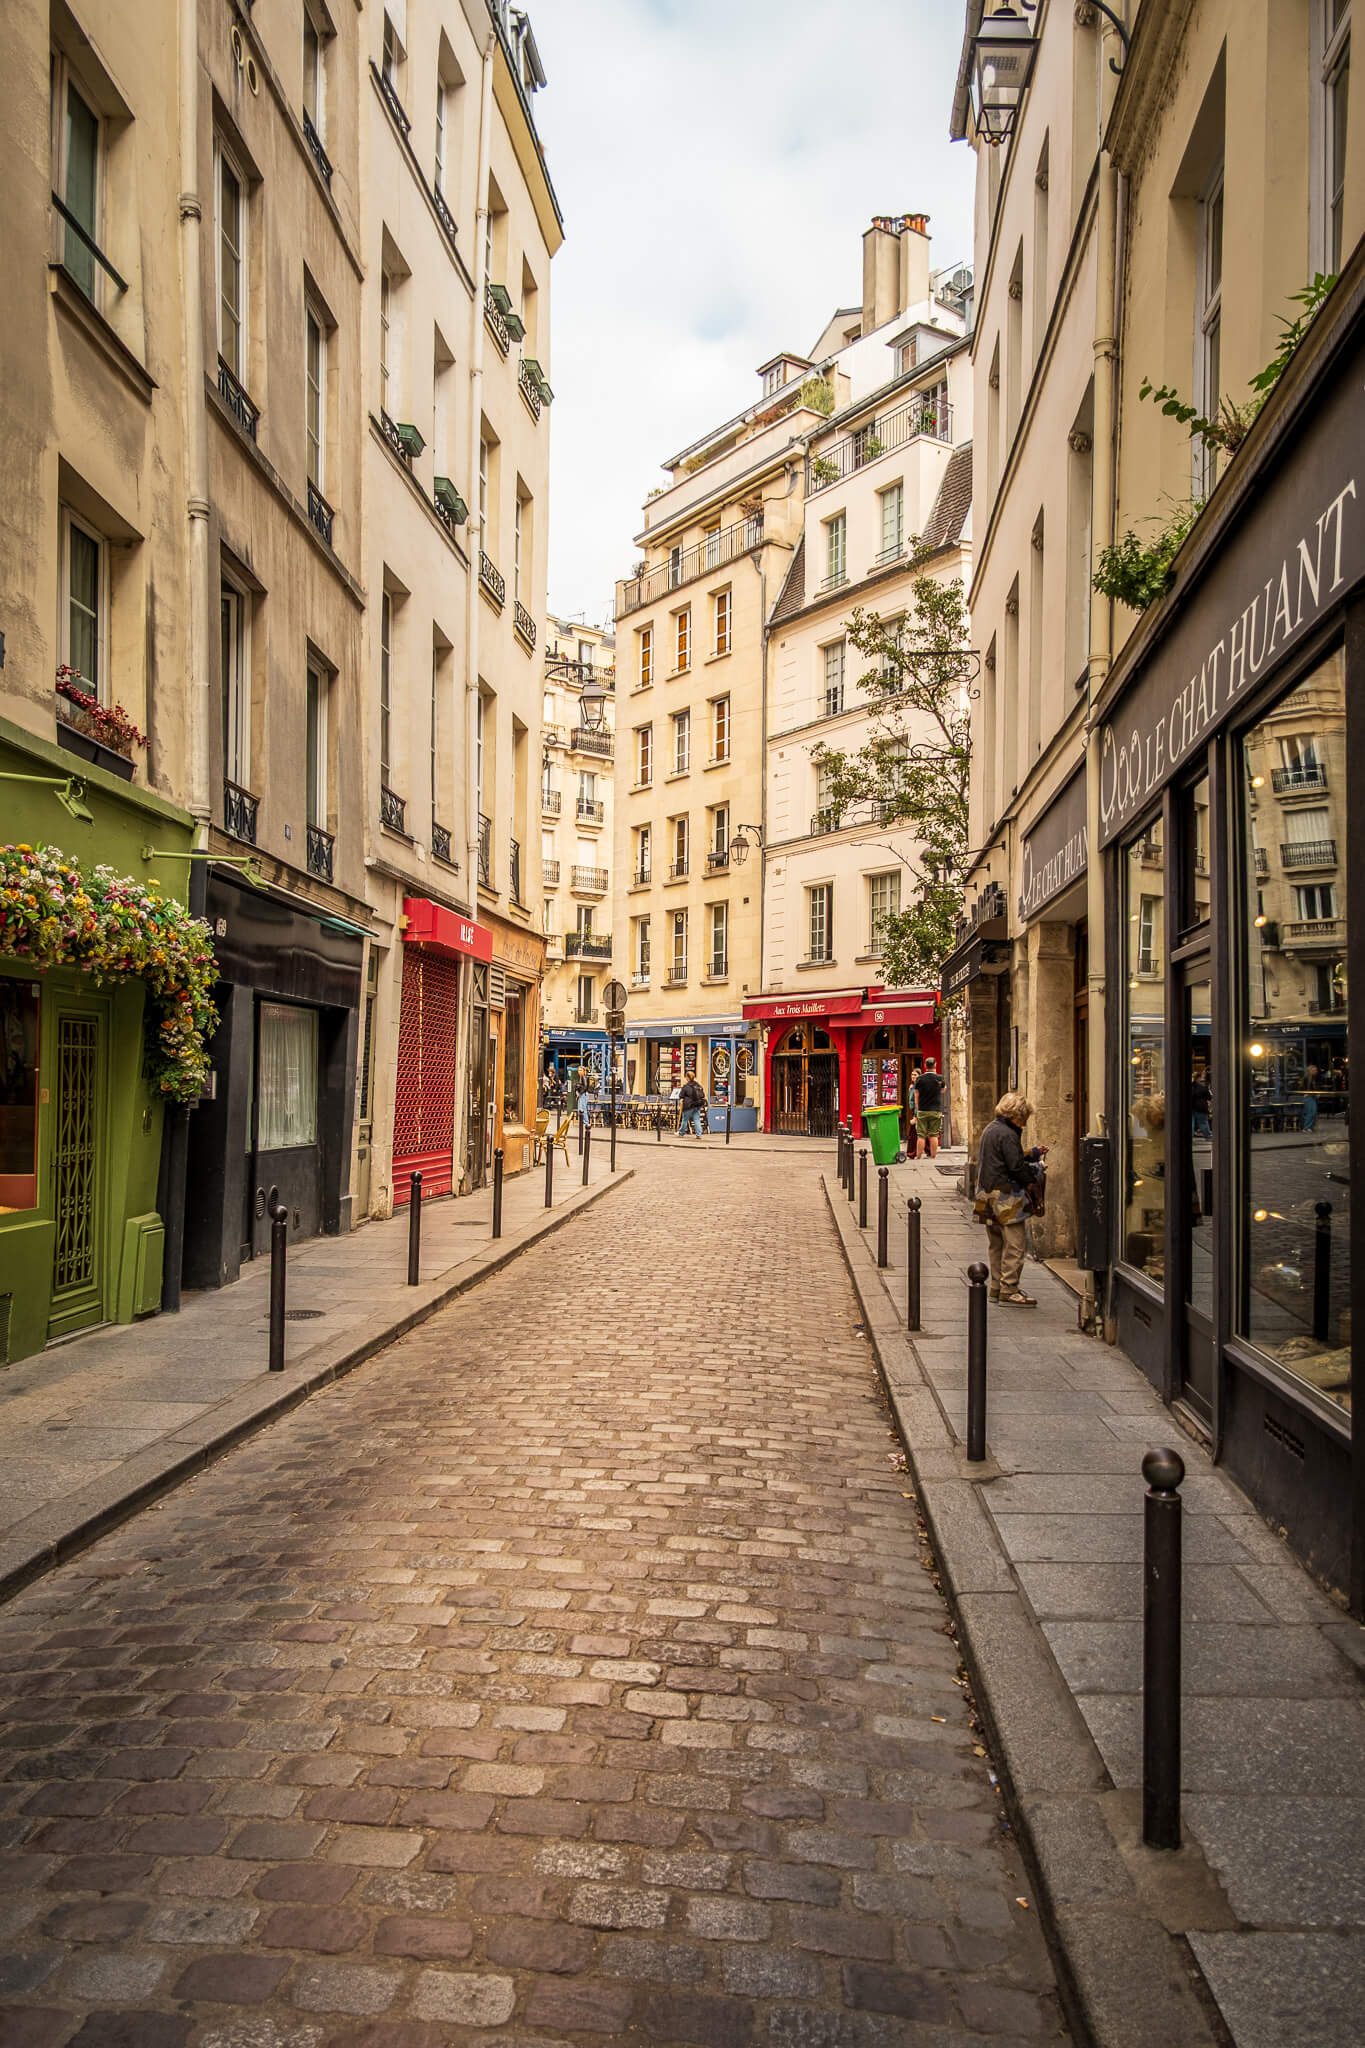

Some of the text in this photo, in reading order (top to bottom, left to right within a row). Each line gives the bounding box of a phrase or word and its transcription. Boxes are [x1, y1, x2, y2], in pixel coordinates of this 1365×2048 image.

[1144, 479, 1357, 795] LE CHAT HUANT
[1032, 870, 1042, 909] LE
[1042, 848, 1064, 899] CHAT
[773, 1006, 785, 1015] Aux
[787, 1004, 801, 1014] Trois
